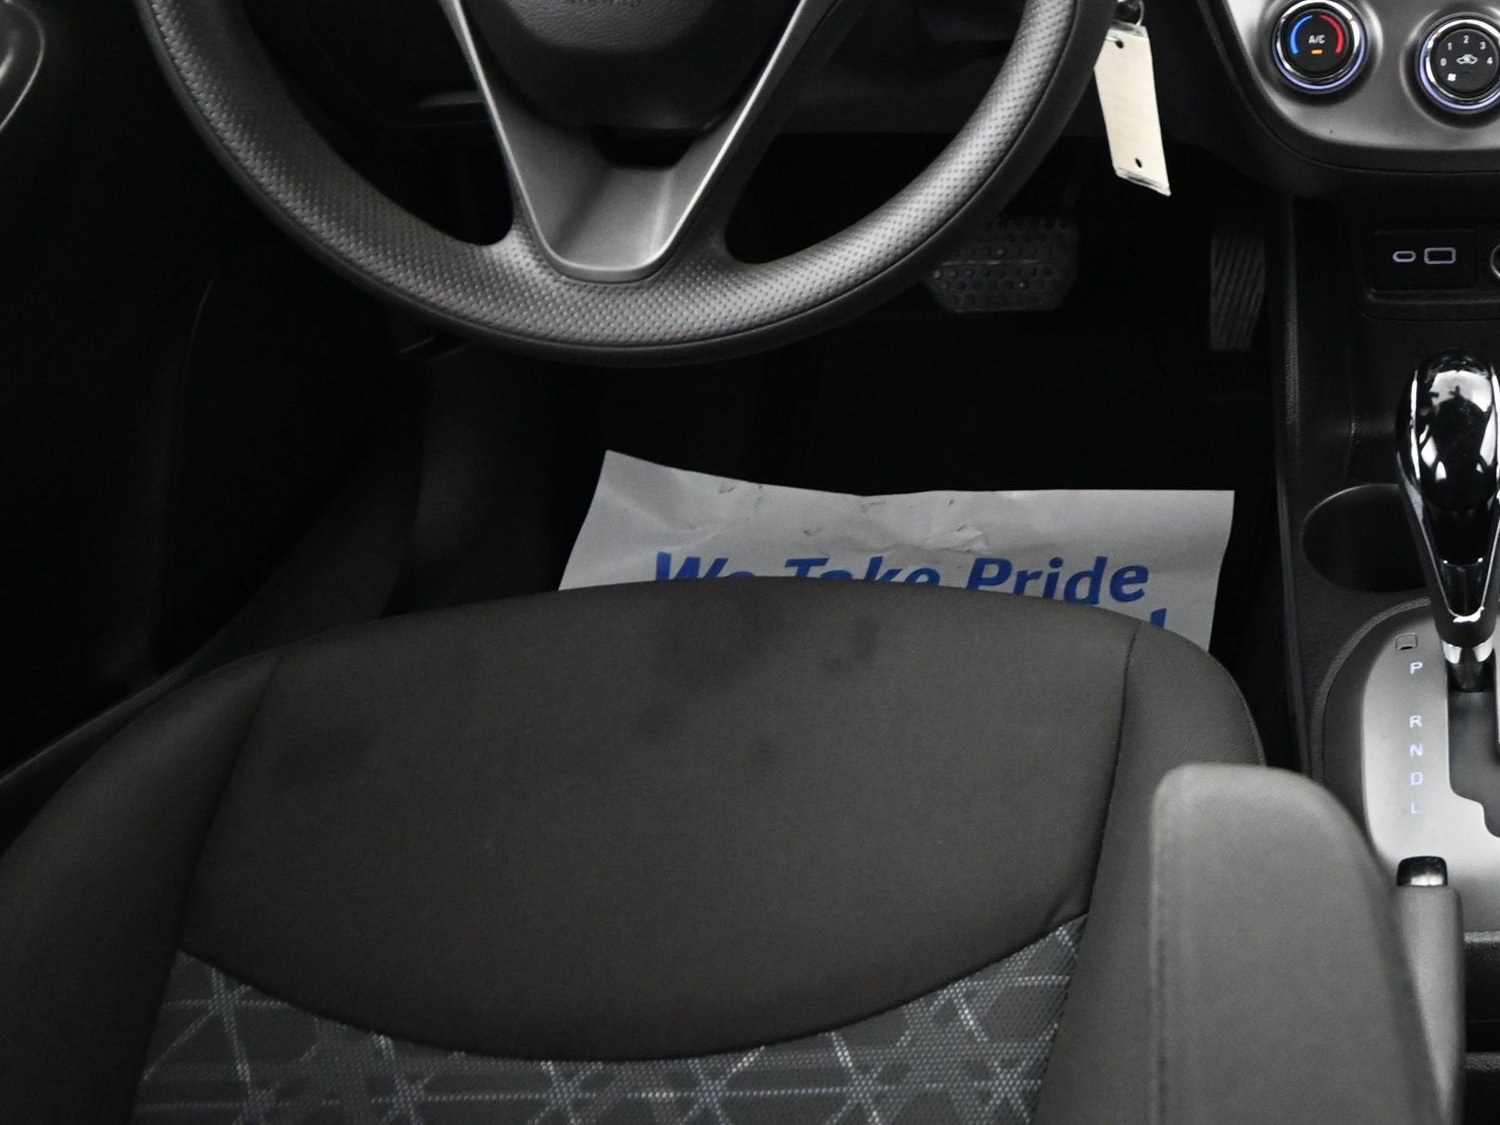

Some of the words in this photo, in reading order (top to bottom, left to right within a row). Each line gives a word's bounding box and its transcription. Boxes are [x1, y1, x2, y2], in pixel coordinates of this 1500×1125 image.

[1308, 34, 1325, 45] A/C
[1463, 35, 1470, 44] 2
[1447, 42, 1453, 51] 1
[1479, 41, 1486, 51] 3
[1440, 58, 1447, 67] 0
[1486, 57, 1494, 66] 4
[1410, 661, 1423, 674] P
[1409, 715, 1422, 728] R
[1410, 744, 1424, 757] N
[1410, 773, 1423, 786] D
[1411, 802, 1421, 815] L
